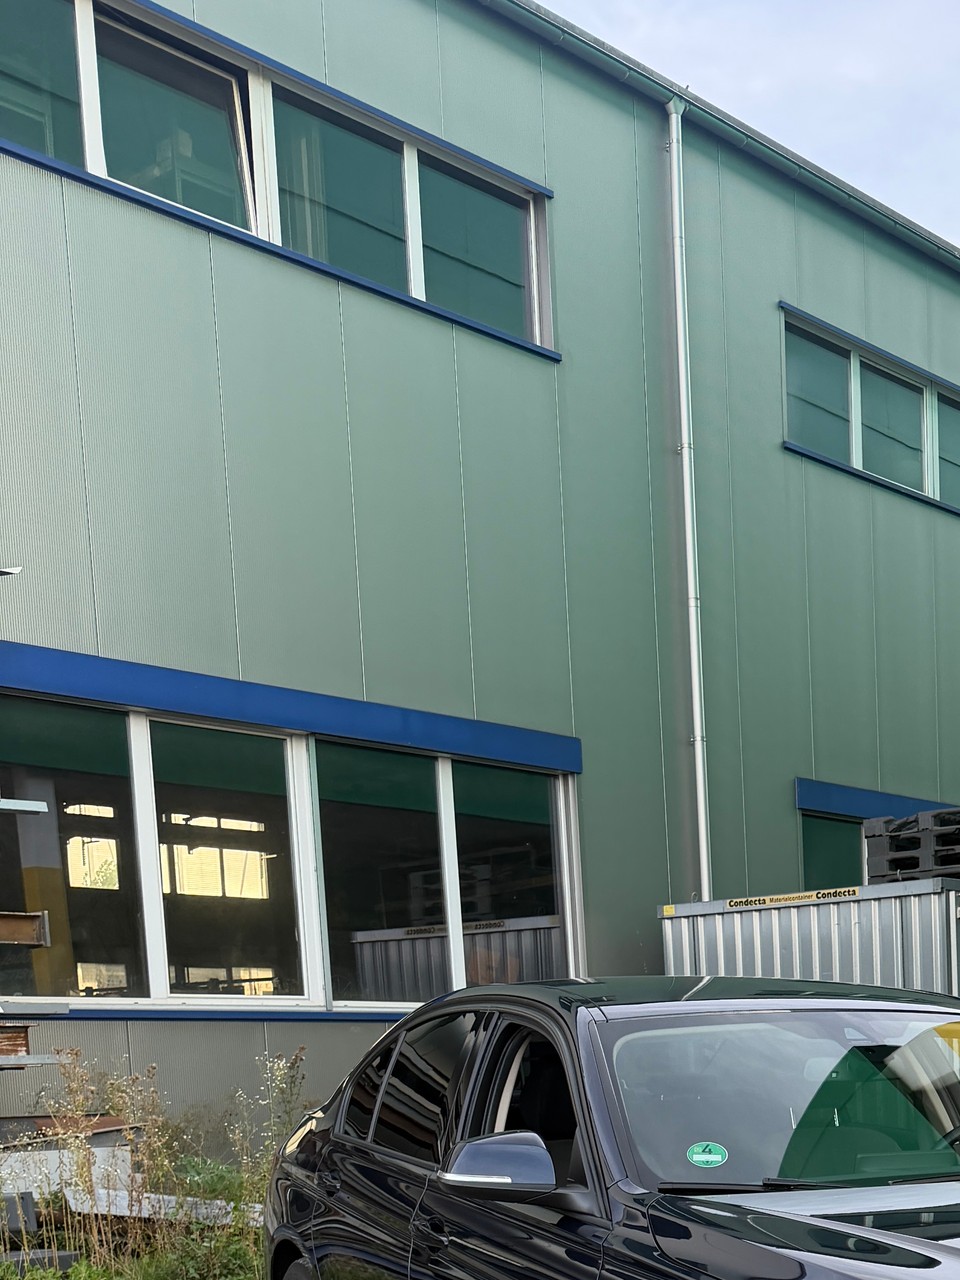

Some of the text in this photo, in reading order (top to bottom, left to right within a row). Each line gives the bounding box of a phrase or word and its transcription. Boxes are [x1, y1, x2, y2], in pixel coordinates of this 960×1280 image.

[728, 888, 856, 908] Condecta Materialcontainer Condecta
[701, 1144, 713, 1155] 4
